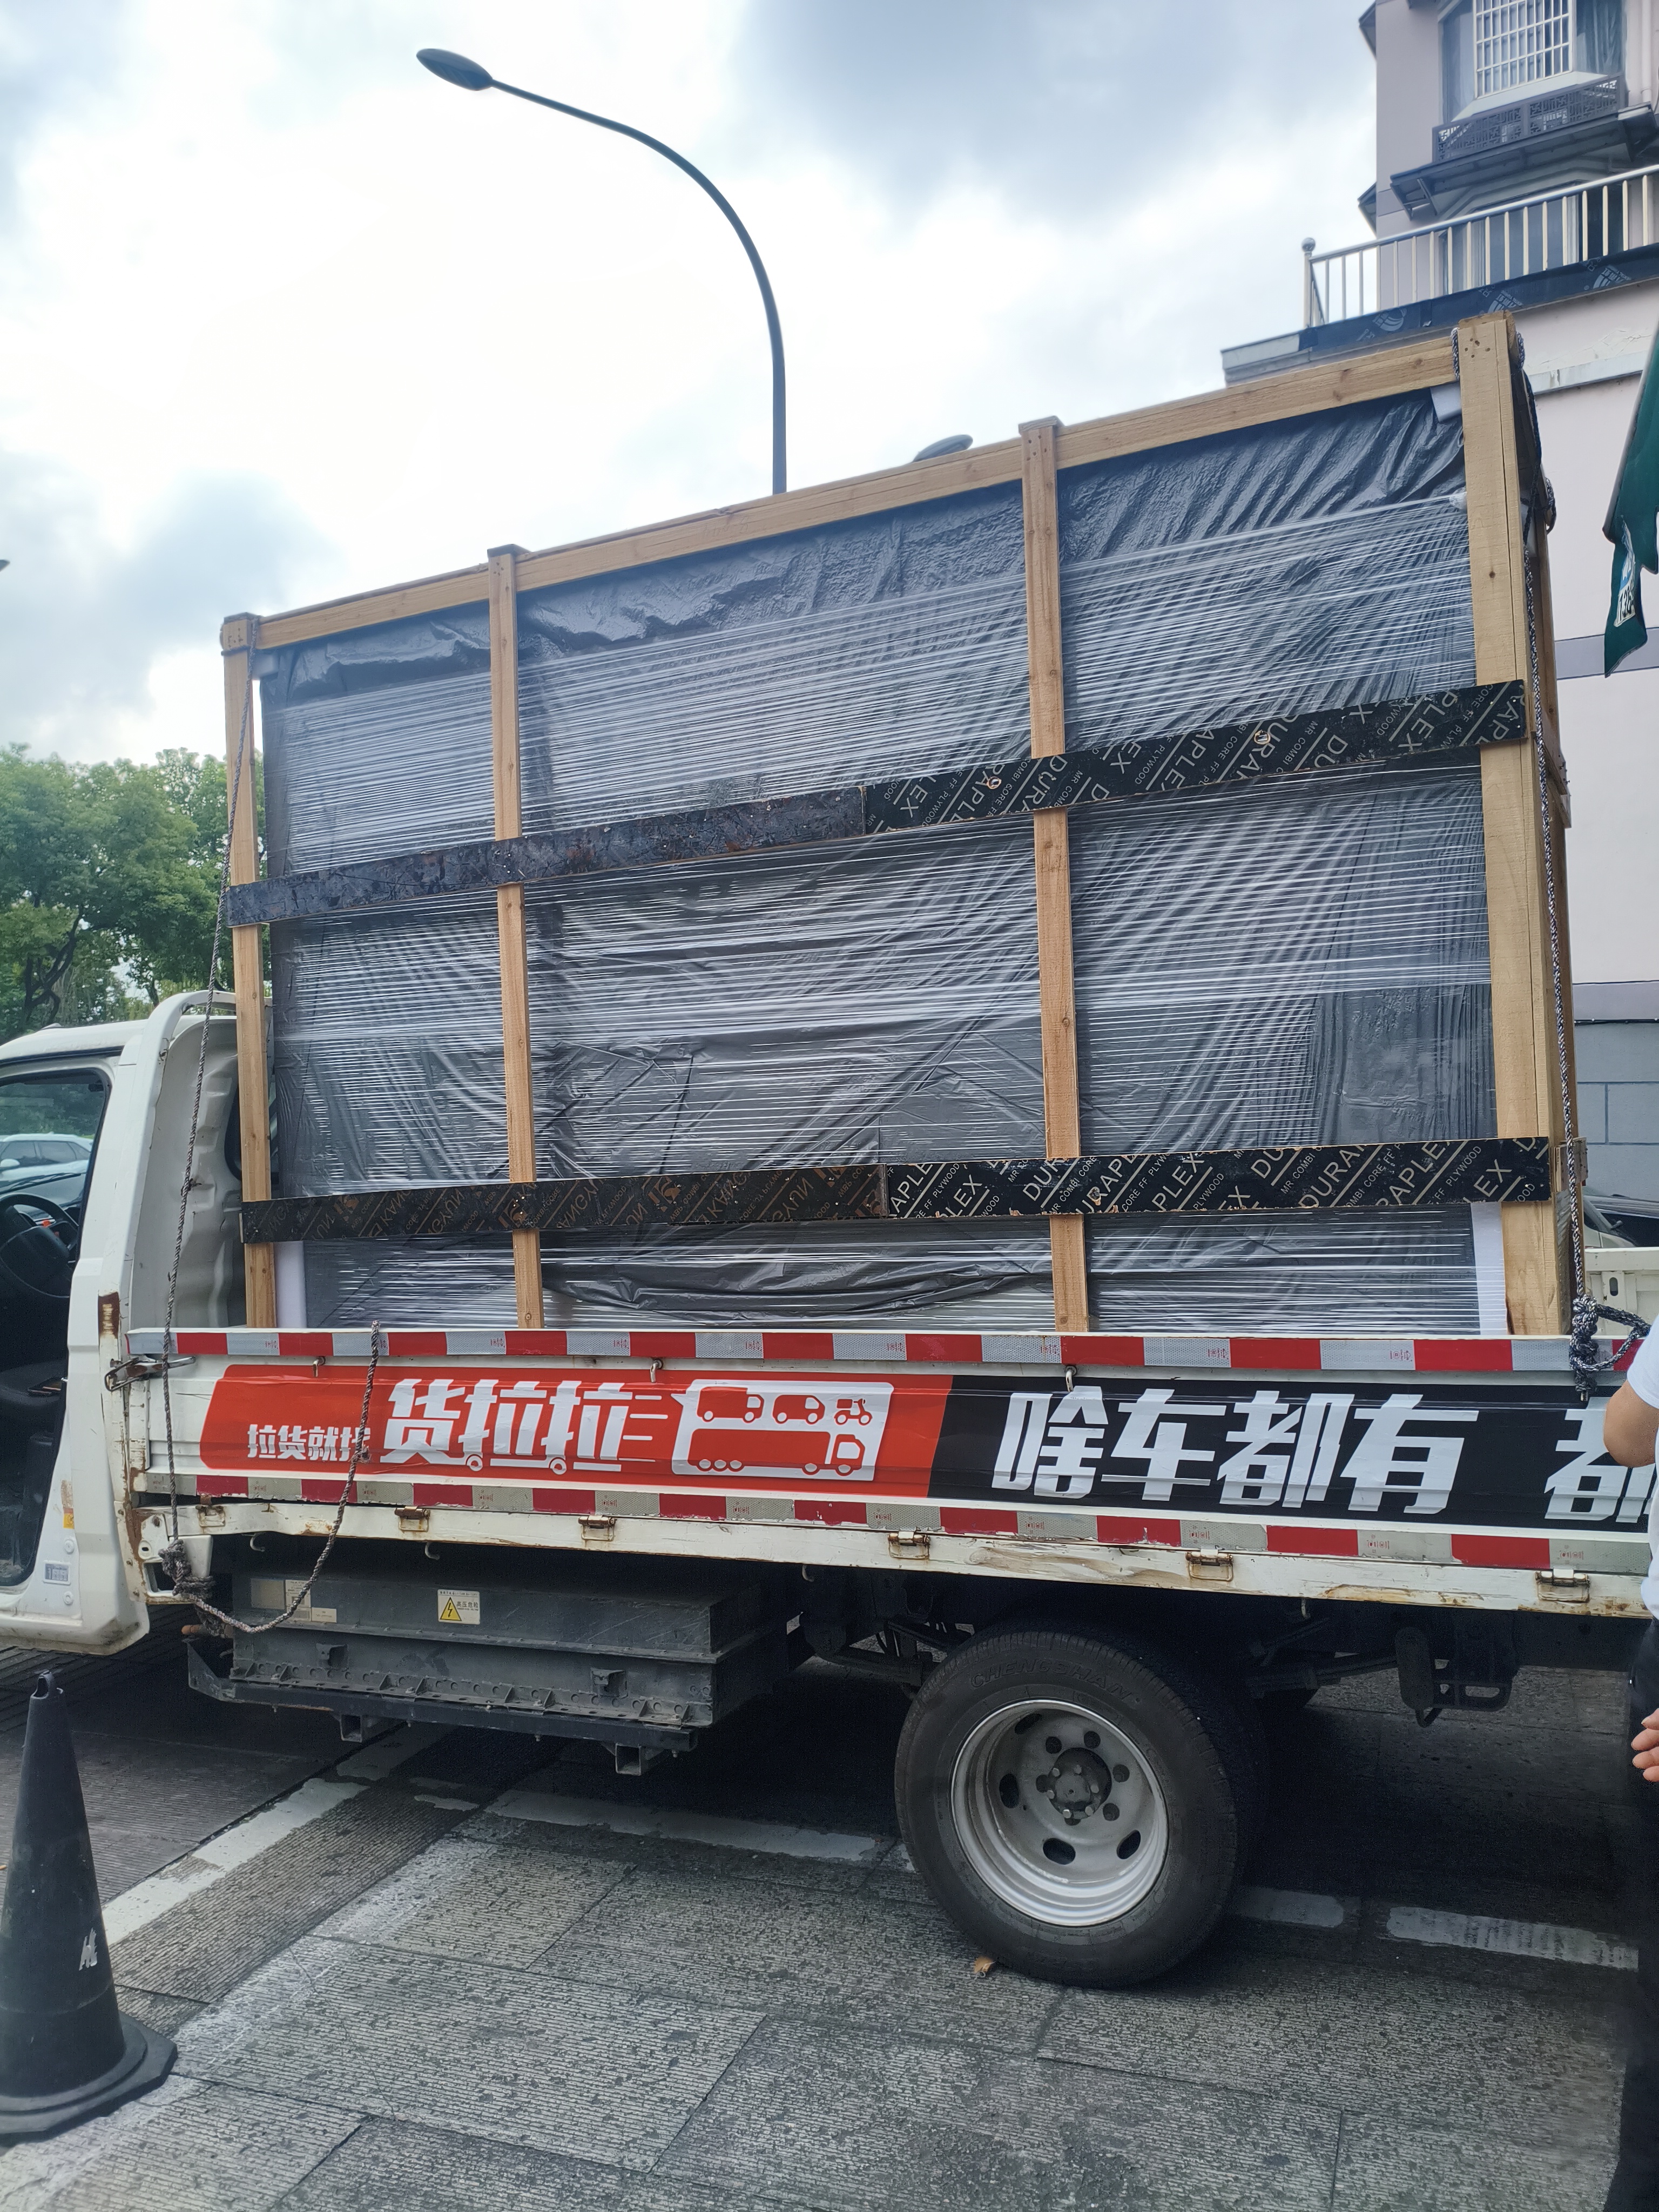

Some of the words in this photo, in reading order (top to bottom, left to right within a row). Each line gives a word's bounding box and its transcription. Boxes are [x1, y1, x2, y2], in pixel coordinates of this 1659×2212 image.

[1471, 684, 1494, 709] CORE
[1304, 720, 1318, 736] MR
[1134, 744, 1165, 786] PLYWOOD
[1217, 734, 1238, 761] CORE
[1282, 736, 1306, 767] COMBI
[1071, 770, 1083, 784] MR
[1208, 761, 1219, 773] FF
[923, 1198, 934, 1210] FF
[931, 1162, 961, 1198] PLYWOOD
[1007, 1169, 1020, 1183] MR
[1048, 1202, 1061, 1215] MR
[1058, 1177, 1081, 1203] COMBI
[1078, 1156, 1097, 1177] CORE
[1280, 1179, 1294, 1195] MR
[1292, 1152, 1316, 1180] COMBI
[1363, 1163, 1385, 1189] CORE
[1382, 1151, 1396, 1164] FF
[1434, 1188, 1447, 1201] FF
[1445, 1144, 1483, 1188] PLYWOOD
[1121, 1189, 1141, 1211] CORE
[1138, 1177, 1150, 1189] FF
[1193, 1172, 1225, 1211] PLYWOOD
[247, 1424, 371, 1461] 拉货就找
[380, 1379, 632, 1474] 货拉拉
[992, 1386, 1479, 1514] 啥车都有
[971, 1658, 1132, 1700] CHENGSHAN
